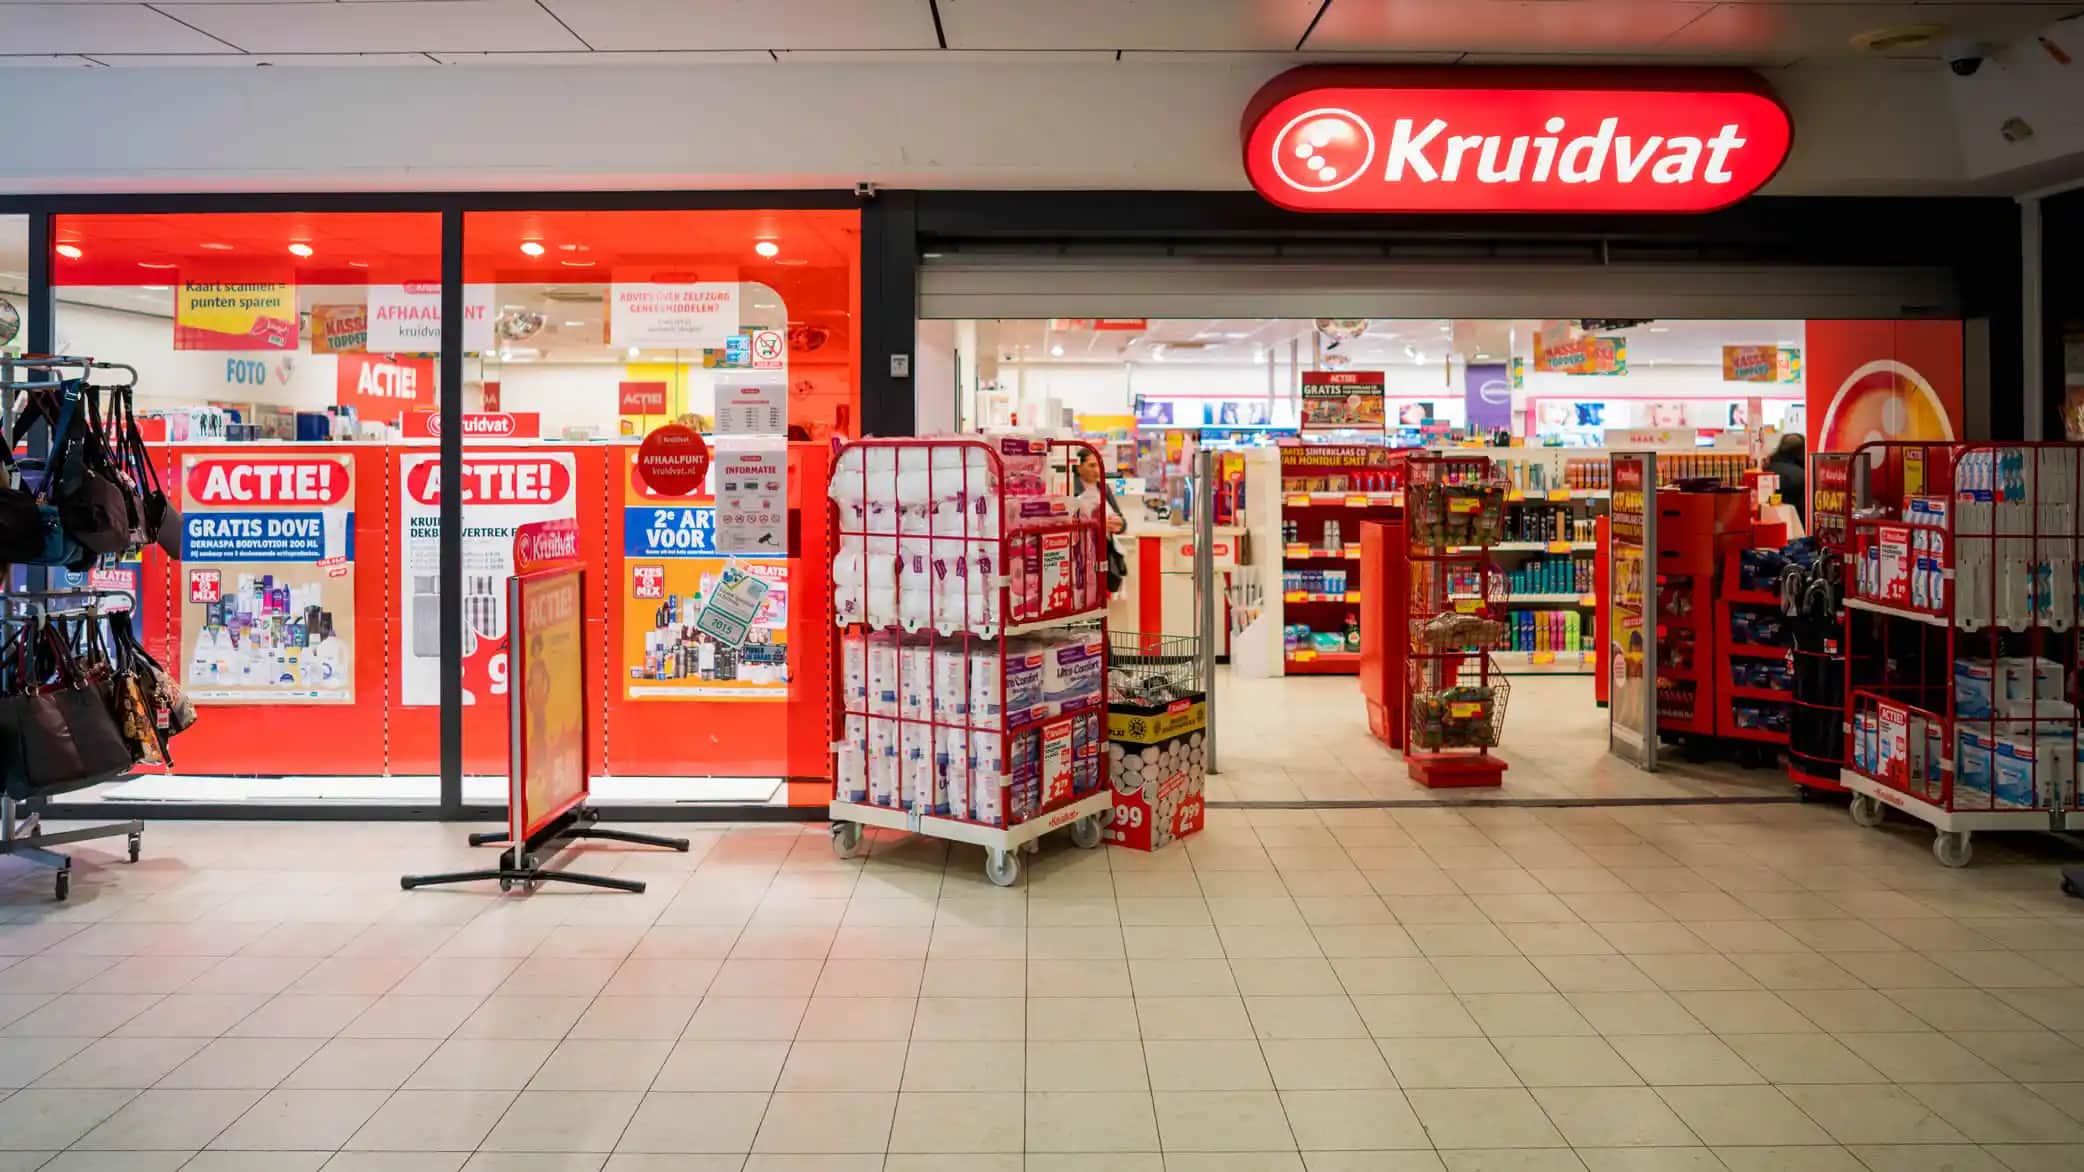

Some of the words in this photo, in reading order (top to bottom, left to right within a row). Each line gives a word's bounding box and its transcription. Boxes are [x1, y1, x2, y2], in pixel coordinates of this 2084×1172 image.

[1384, 116, 1747, 185] Kruidvat
[185, 280, 221, 292] Kaart
[224, 283, 276, 292] scannen
[191, 297, 236, 310] punten
[239, 299, 281, 310] sparen
[226, 358, 266, 385] FOTO
[357, 361, 417, 400] ACTIE!
[1303, 384, 1342, 395] GRATIS
[643, 455, 705, 465] AFHAALPUNT
[1299, 456, 1342, 465] MONIQUE
[1343, 456, 1367, 465] SMIT
[725, 465, 777, 475] INFORMATIE
[201, 464, 332, 501] ACTIE!
[188, 519, 263, 537] GRATIS
[267, 519, 321, 537] DOVE
[190, 540, 235, 549] DERMASPA
[235, 540, 288, 549] BODYLOTION
[289, 540, 305, 549] 200
[646, 529, 705, 548] VOOR
[533, 532, 576, 561] Kruidvat
[192, 590, 217, 601] MIX
[636, 586, 660, 596] MIX
[711, 618, 733, 634] 2015
